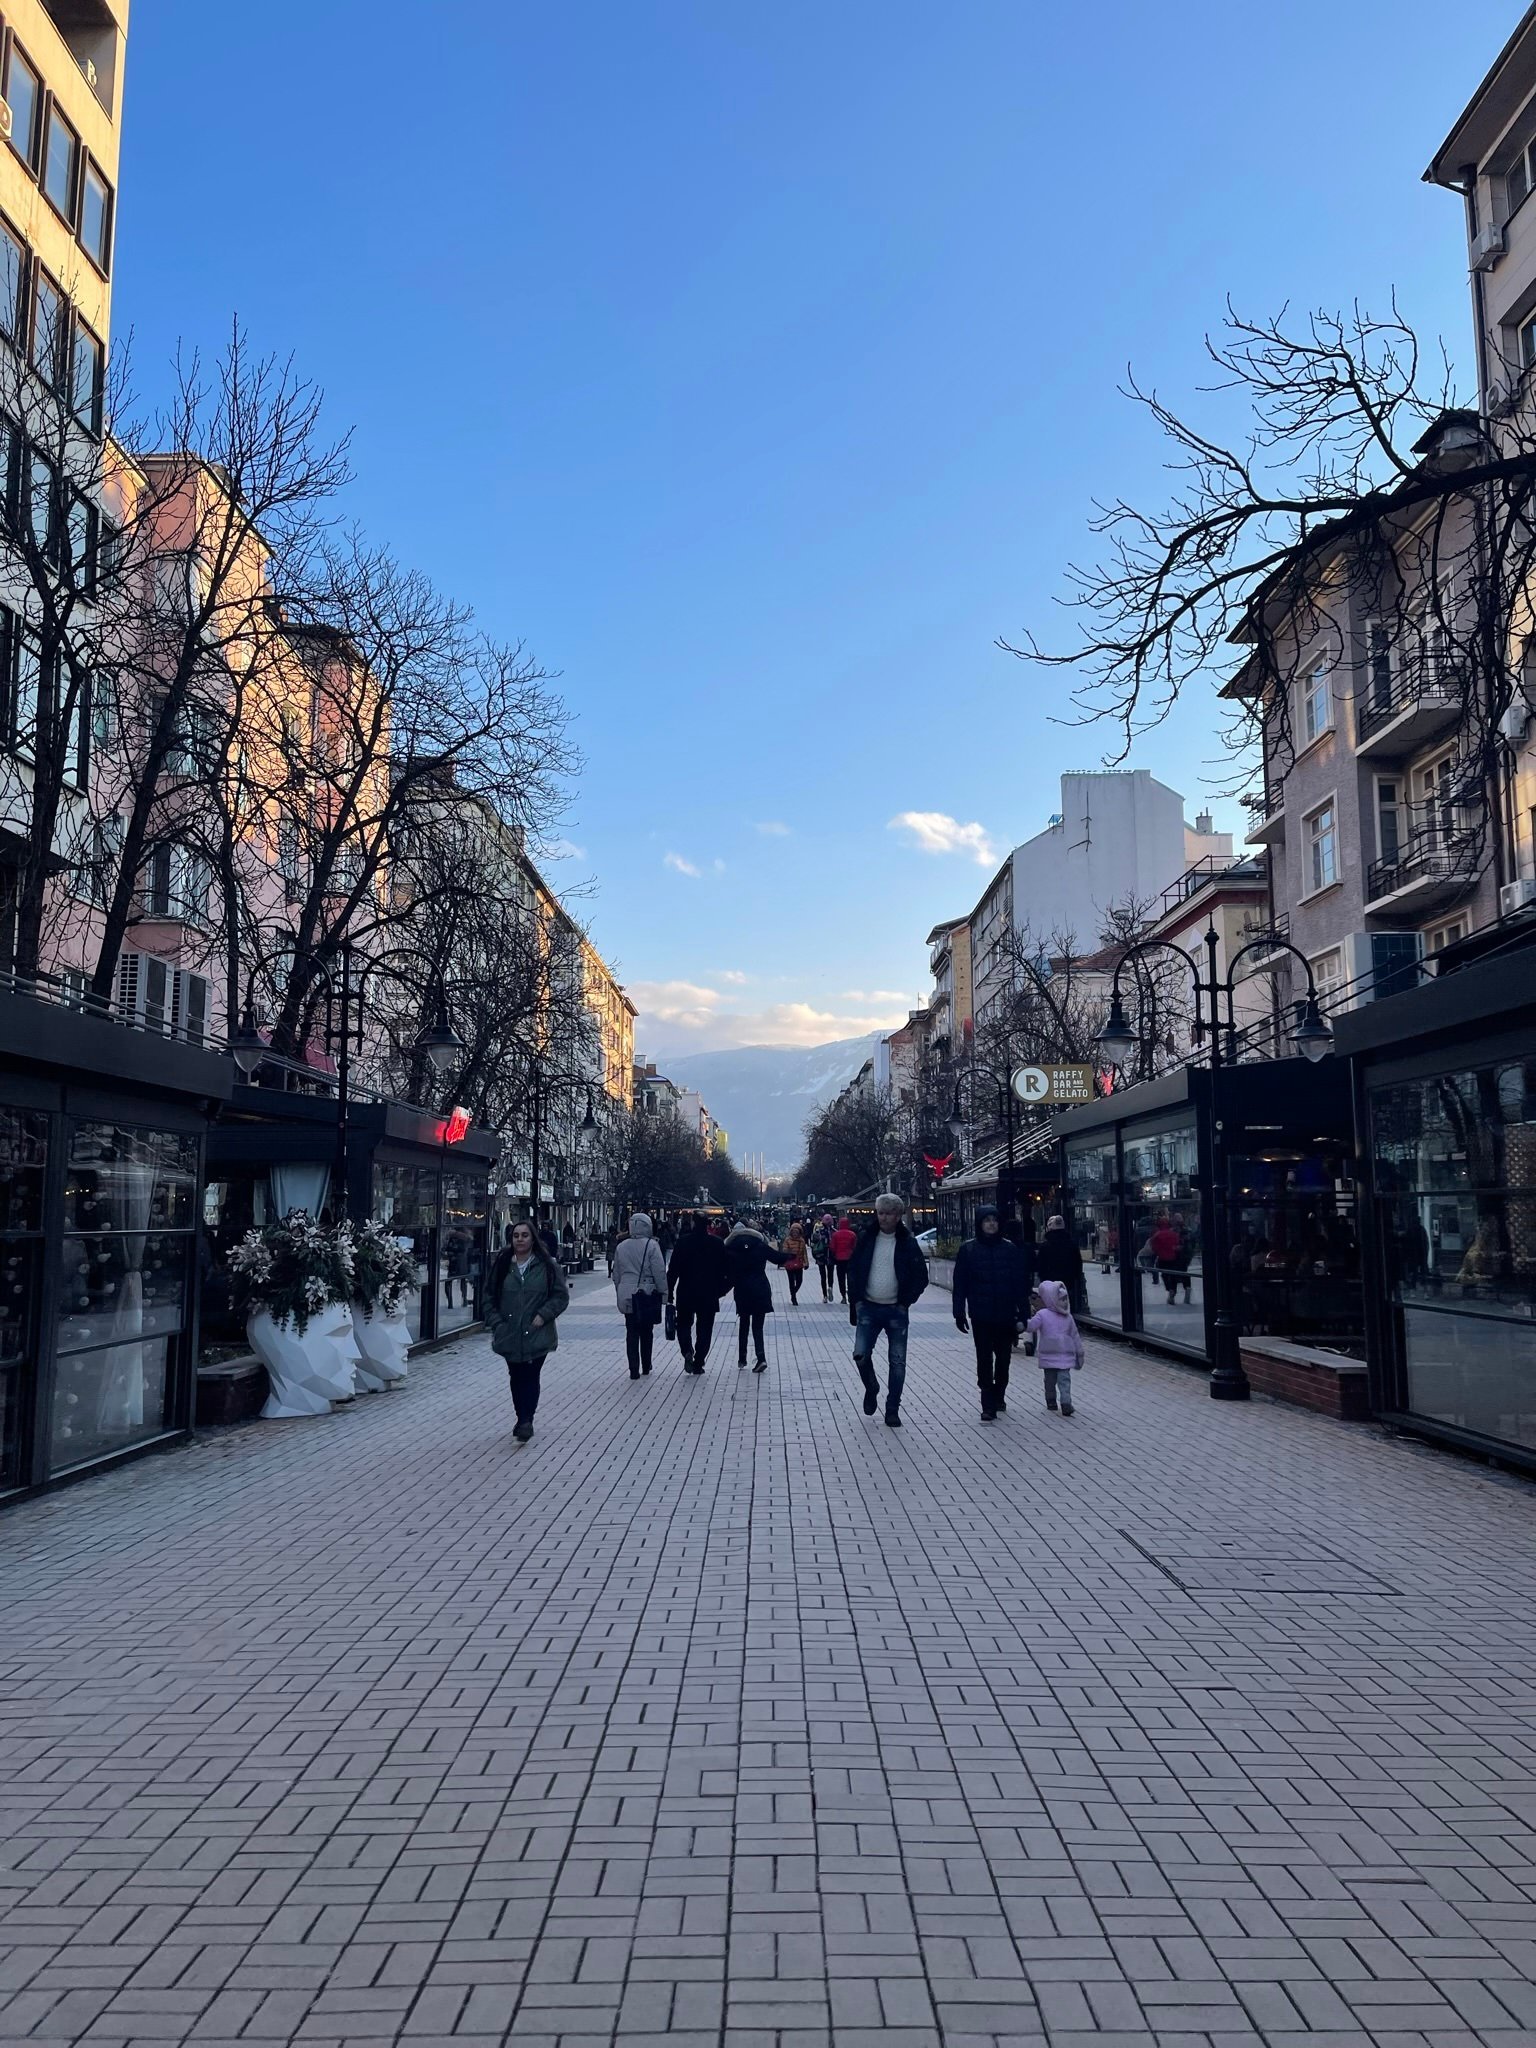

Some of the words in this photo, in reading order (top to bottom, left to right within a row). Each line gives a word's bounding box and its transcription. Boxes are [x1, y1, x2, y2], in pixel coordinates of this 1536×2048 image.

[1053, 1070, 1083, 1079] RAFFY
[1025, 1075, 1041, 1092] R
[1053, 1080, 1071, 1088] BAR
[1053, 1089, 1088, 1098] GELATO
